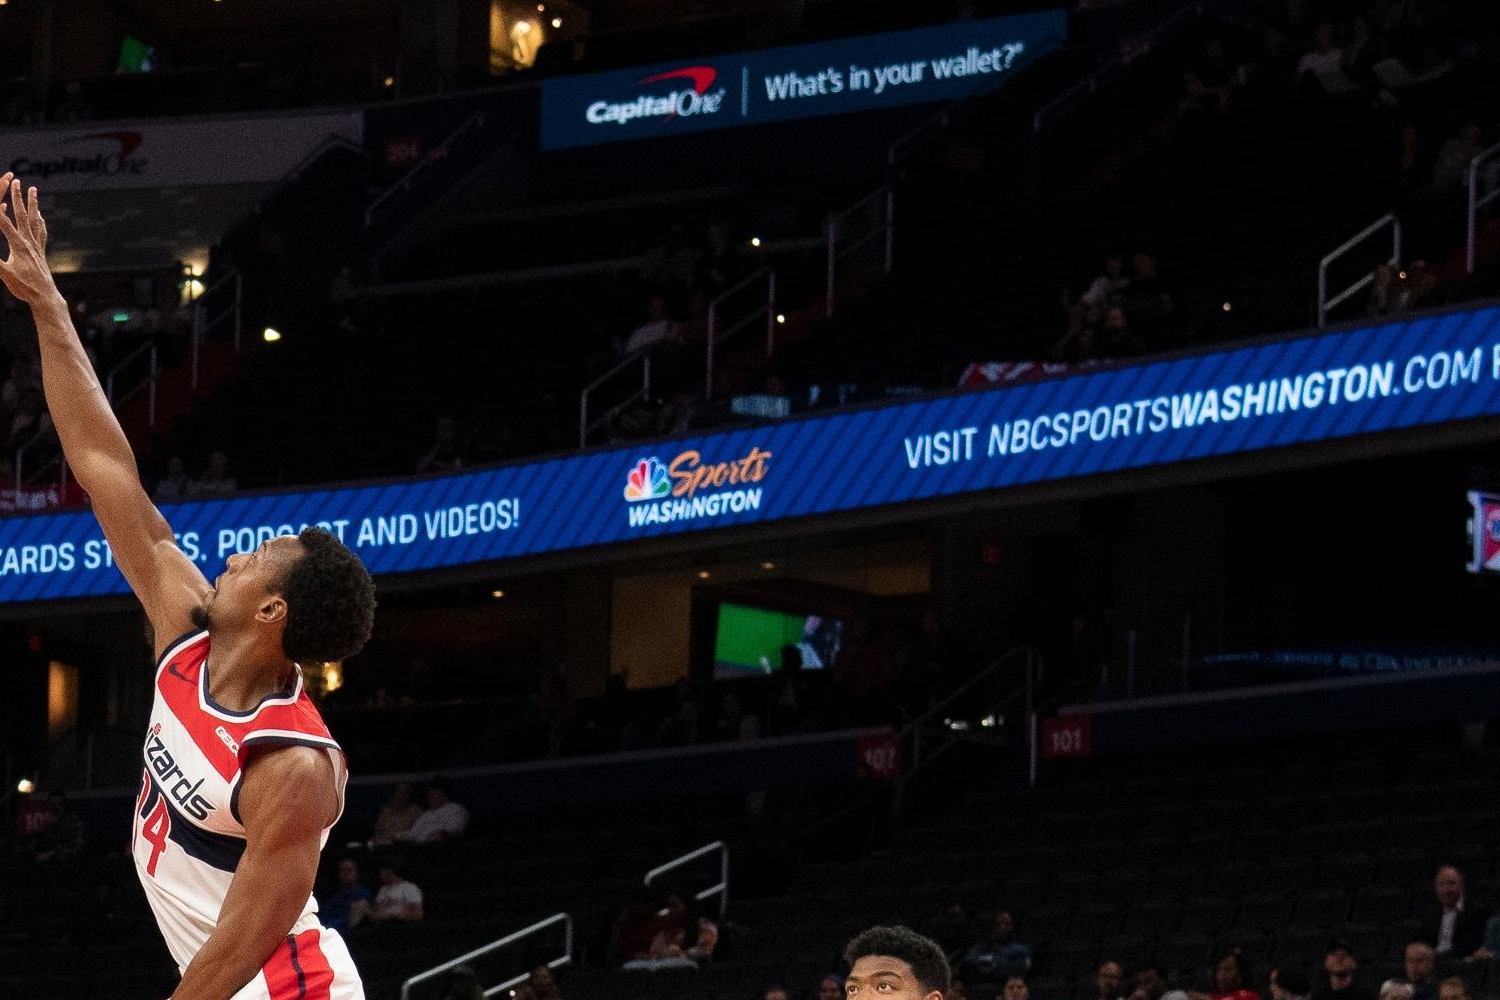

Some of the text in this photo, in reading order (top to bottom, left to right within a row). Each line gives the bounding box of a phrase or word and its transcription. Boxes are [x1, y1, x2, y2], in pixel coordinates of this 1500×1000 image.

[764, 67, 844, 102] What's
[849, 65, 870, 91] in
[873, 59, 928, 95] your
[903, 426, 980, 469] VISIT
[986, 346, 1483, 458] NBCSPORTSWASHINGTON.COM
[669, 446, 773, 499] Sports
[356, 512, 420, 547] AND
[424, 497, 522, 539] VIDEOS!
